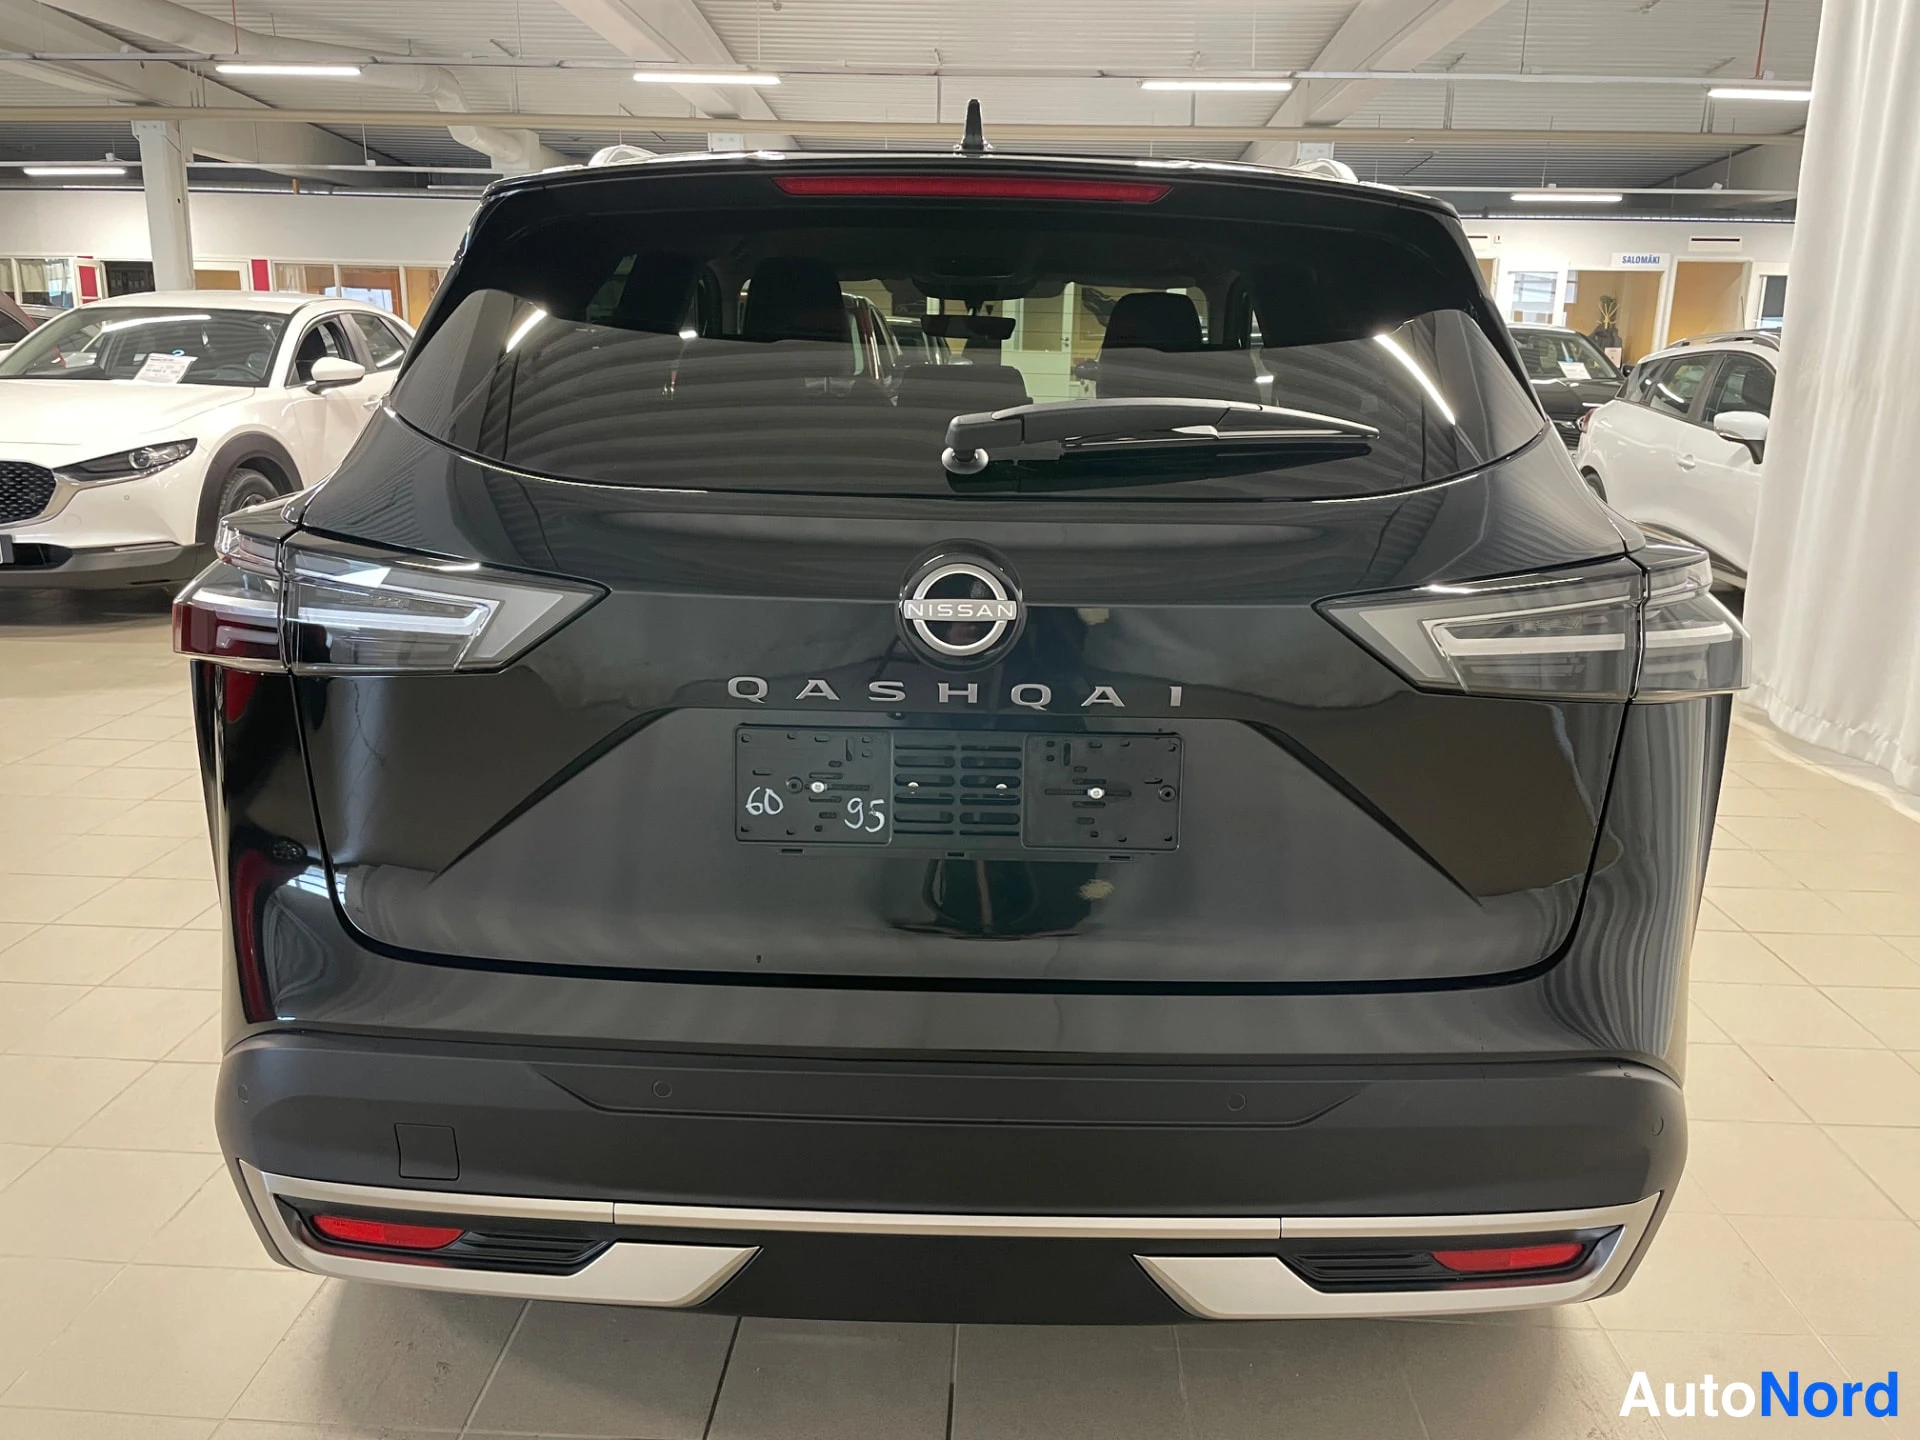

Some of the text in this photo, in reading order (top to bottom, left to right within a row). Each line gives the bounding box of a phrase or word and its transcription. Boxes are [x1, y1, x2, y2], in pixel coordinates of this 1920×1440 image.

[1622, 254, 1660, 264] SALOMÄKI
[907, 603, 1015, 618] NISSAN
[727, 676, 1183, 710] QASHQAI
[745, 787, 886, 833] 60 95
